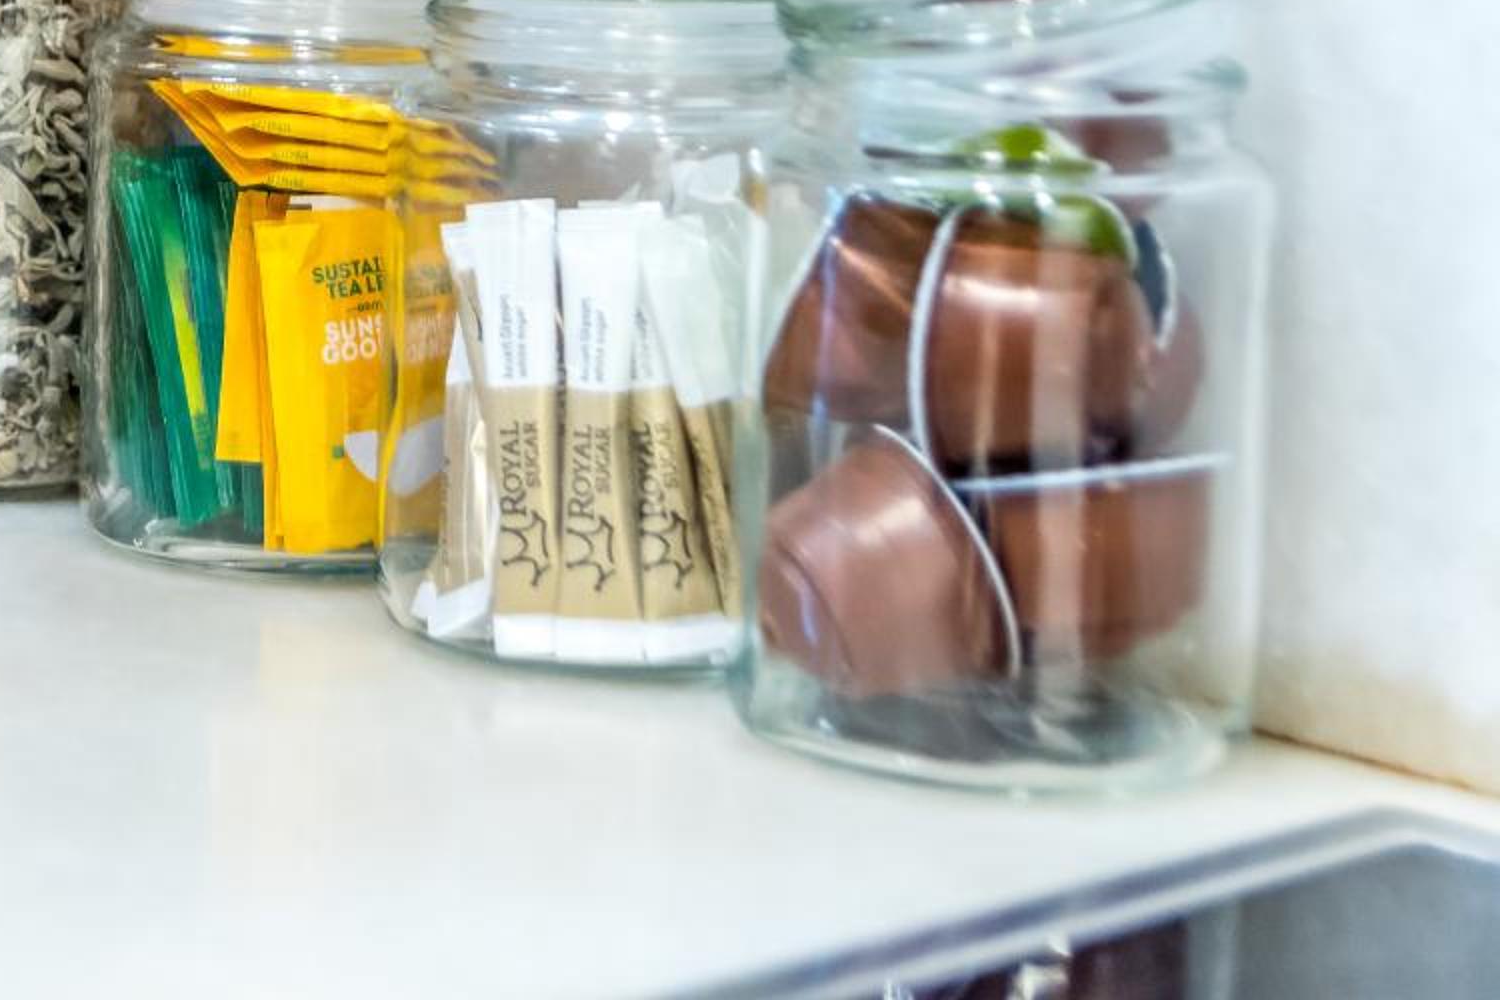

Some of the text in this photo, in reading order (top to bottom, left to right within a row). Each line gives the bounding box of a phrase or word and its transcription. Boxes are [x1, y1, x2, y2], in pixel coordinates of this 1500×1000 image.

[326, 278, 363, 299] TEA
[500, 421, 527, 517] ROYAL
[523, 422, 542, 489] SUGAR
[567, 423, 596, 520] ROYAL
[595, 426, 613, 495] SUGAR
